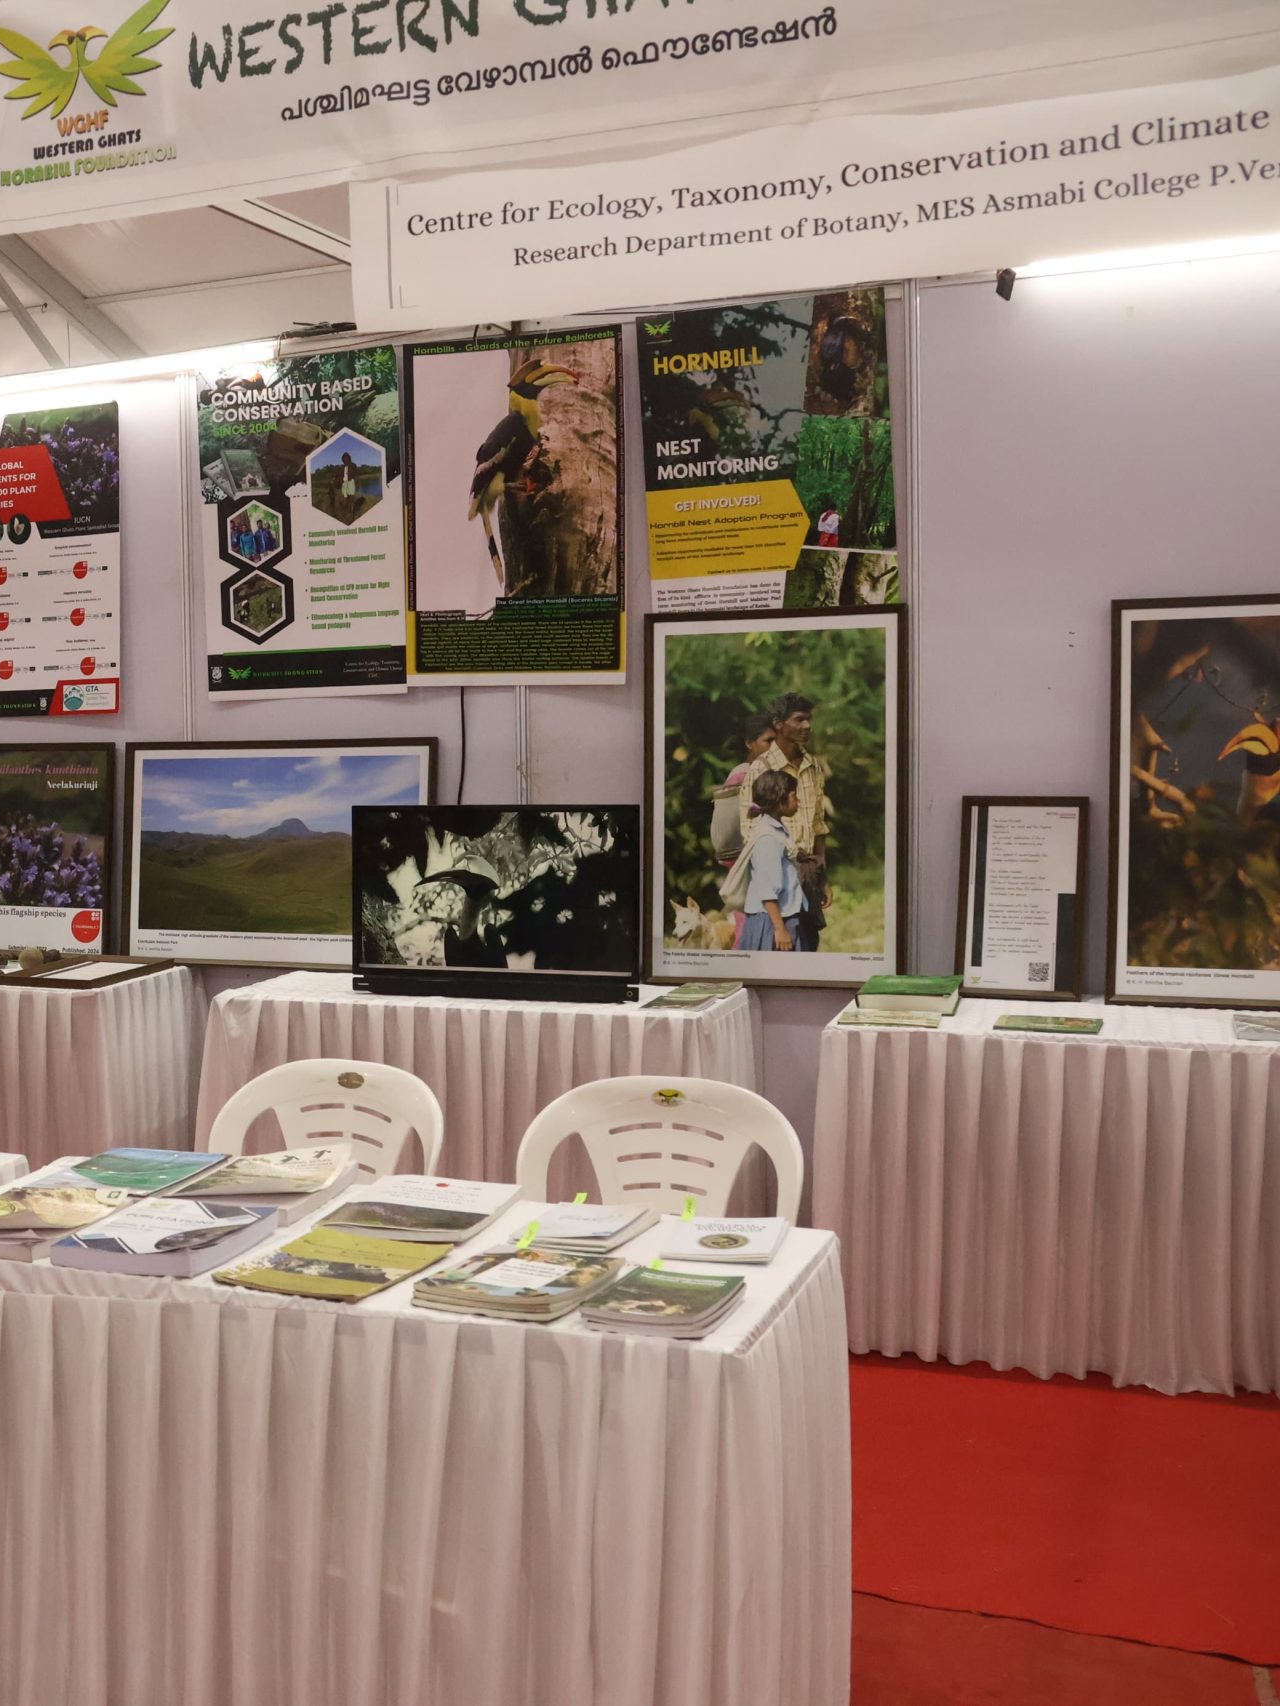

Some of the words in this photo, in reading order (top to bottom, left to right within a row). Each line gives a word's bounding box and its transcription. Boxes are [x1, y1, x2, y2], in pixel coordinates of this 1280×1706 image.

[189, 0, 480, 88] WESTERN
[56, 109, 110, 137] WGHF
[33, 137, 95, 160] WESTERN
[98, 129, 142, 150] GHATS
[407, 205, 495, 238] Centre
[500, 199, 541, 227] for
[548, 189, 664, 222] Ecology,
[672, 172, 832, 210] Taxonomy,
[841, 140, 1050, 189] Conservation
[1059, 124, 1121, 159] and
[1131, 107, 1271, 149] Climate
[514, 238, 618, 267] Research
[625, 222, 772, 261] Department
[780, 217, 810, 240] of
[812, 209, 909, 240] Botany,
[917, 197, 976, 224] MES
[982, 181, 1086, 216] Asmabi
[1094, 168, 1201, 207] College
[1210, 159, 1280, 187] P.Ve
[414, 345, 455, 356] Hornbills
[466, 342, 500, 354] Guards
[502, 340, 512, 351] of
[516, 339, 531, 349] the
[534, 337, 563, 349] Future
[565, 330, 615, 344] Rainforests
[652, 346, 764, 376] HORNBILL
[211, 380, 317, 407] COMMUNITY
[322, 375, 373, 395] BASED
[212, 397, 344, 424] CONSERVATION
[249, 422, 278, 435] 2004
[656, 438, 701, 458] NEST
[19, 473, 36, 482] FOR
[658, 454, 779, 482] MONITORING
[10, 485, 37, 496] PLANT
[675, 501, 697, 512] GET
[699, 494, 762, 510] INVOLVED!
[74, 515, 91, 524] IUCN
[650, 519, 686, 529] Hornbill
[688, 518, 712, 526] Nest
[714, 514, 758, 525] Adoption
[760, 511, 803, 521] Program
[85, 685, 99, 693] GTA
[46, 780, 98, 791] Neelakurinji
[11, 908, 39, 918] flagship
[40, 911, 67, 920] species
